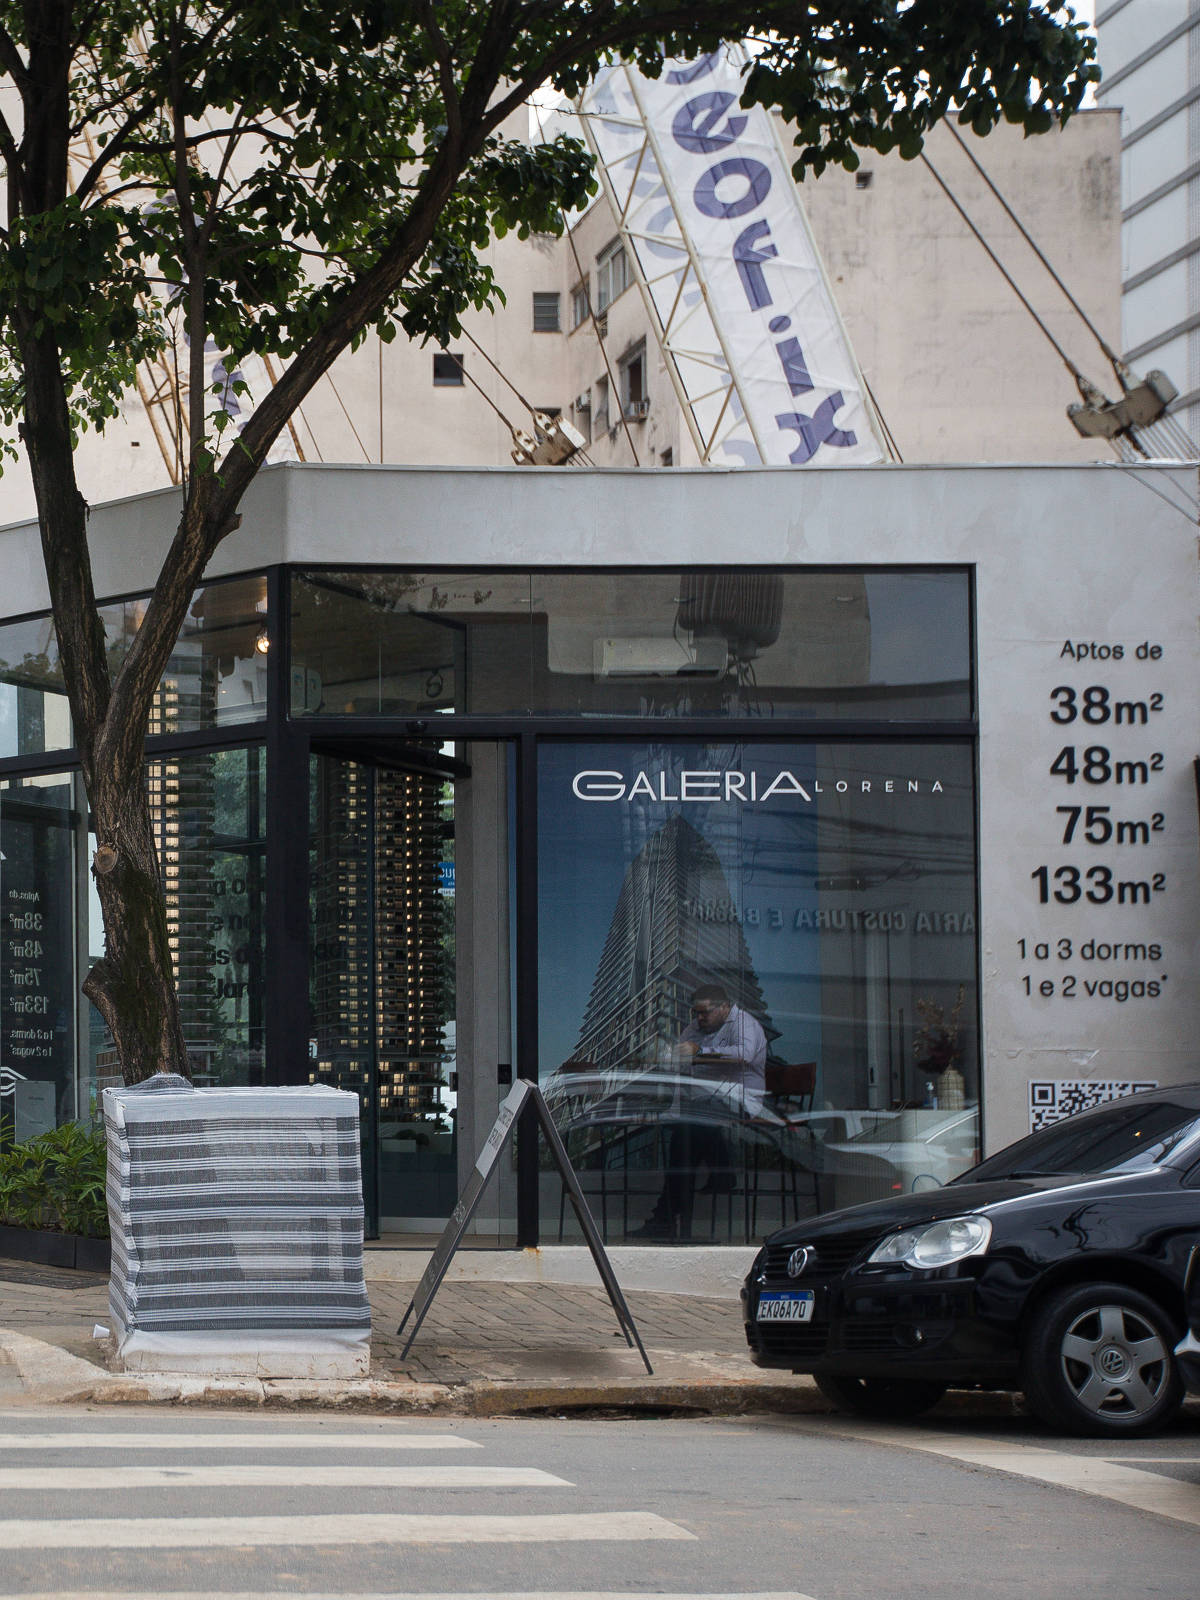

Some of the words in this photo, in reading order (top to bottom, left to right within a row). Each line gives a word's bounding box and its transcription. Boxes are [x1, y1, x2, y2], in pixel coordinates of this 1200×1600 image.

[1060, 640, 1124, 663] Aptos
[1135, 641, 1163, 660] de
[1050, 686, 1164, 725] 38m²
[1050, 746, 1164, 784] 48m²
[572, 770, 812, 801] GALERIA
[815, 780, 944, 793] LORENA
[1056, 806, 1166, 845] 75m²
[1031, 865, 1167, 905] 133m²
[1017, 938, 1026, 960] 1
[1034, 943, 1049, 960] a
[1057, 938, 1072, 960] 3
[1080, 938, 1162, 960] dorms
[1021, 975, 1031, 996] 1
[1039, 979, 1054, 997] e
[1062, 975, 1076, 997] 2
[760, 1301, 807, 1319] EKQ6A70
